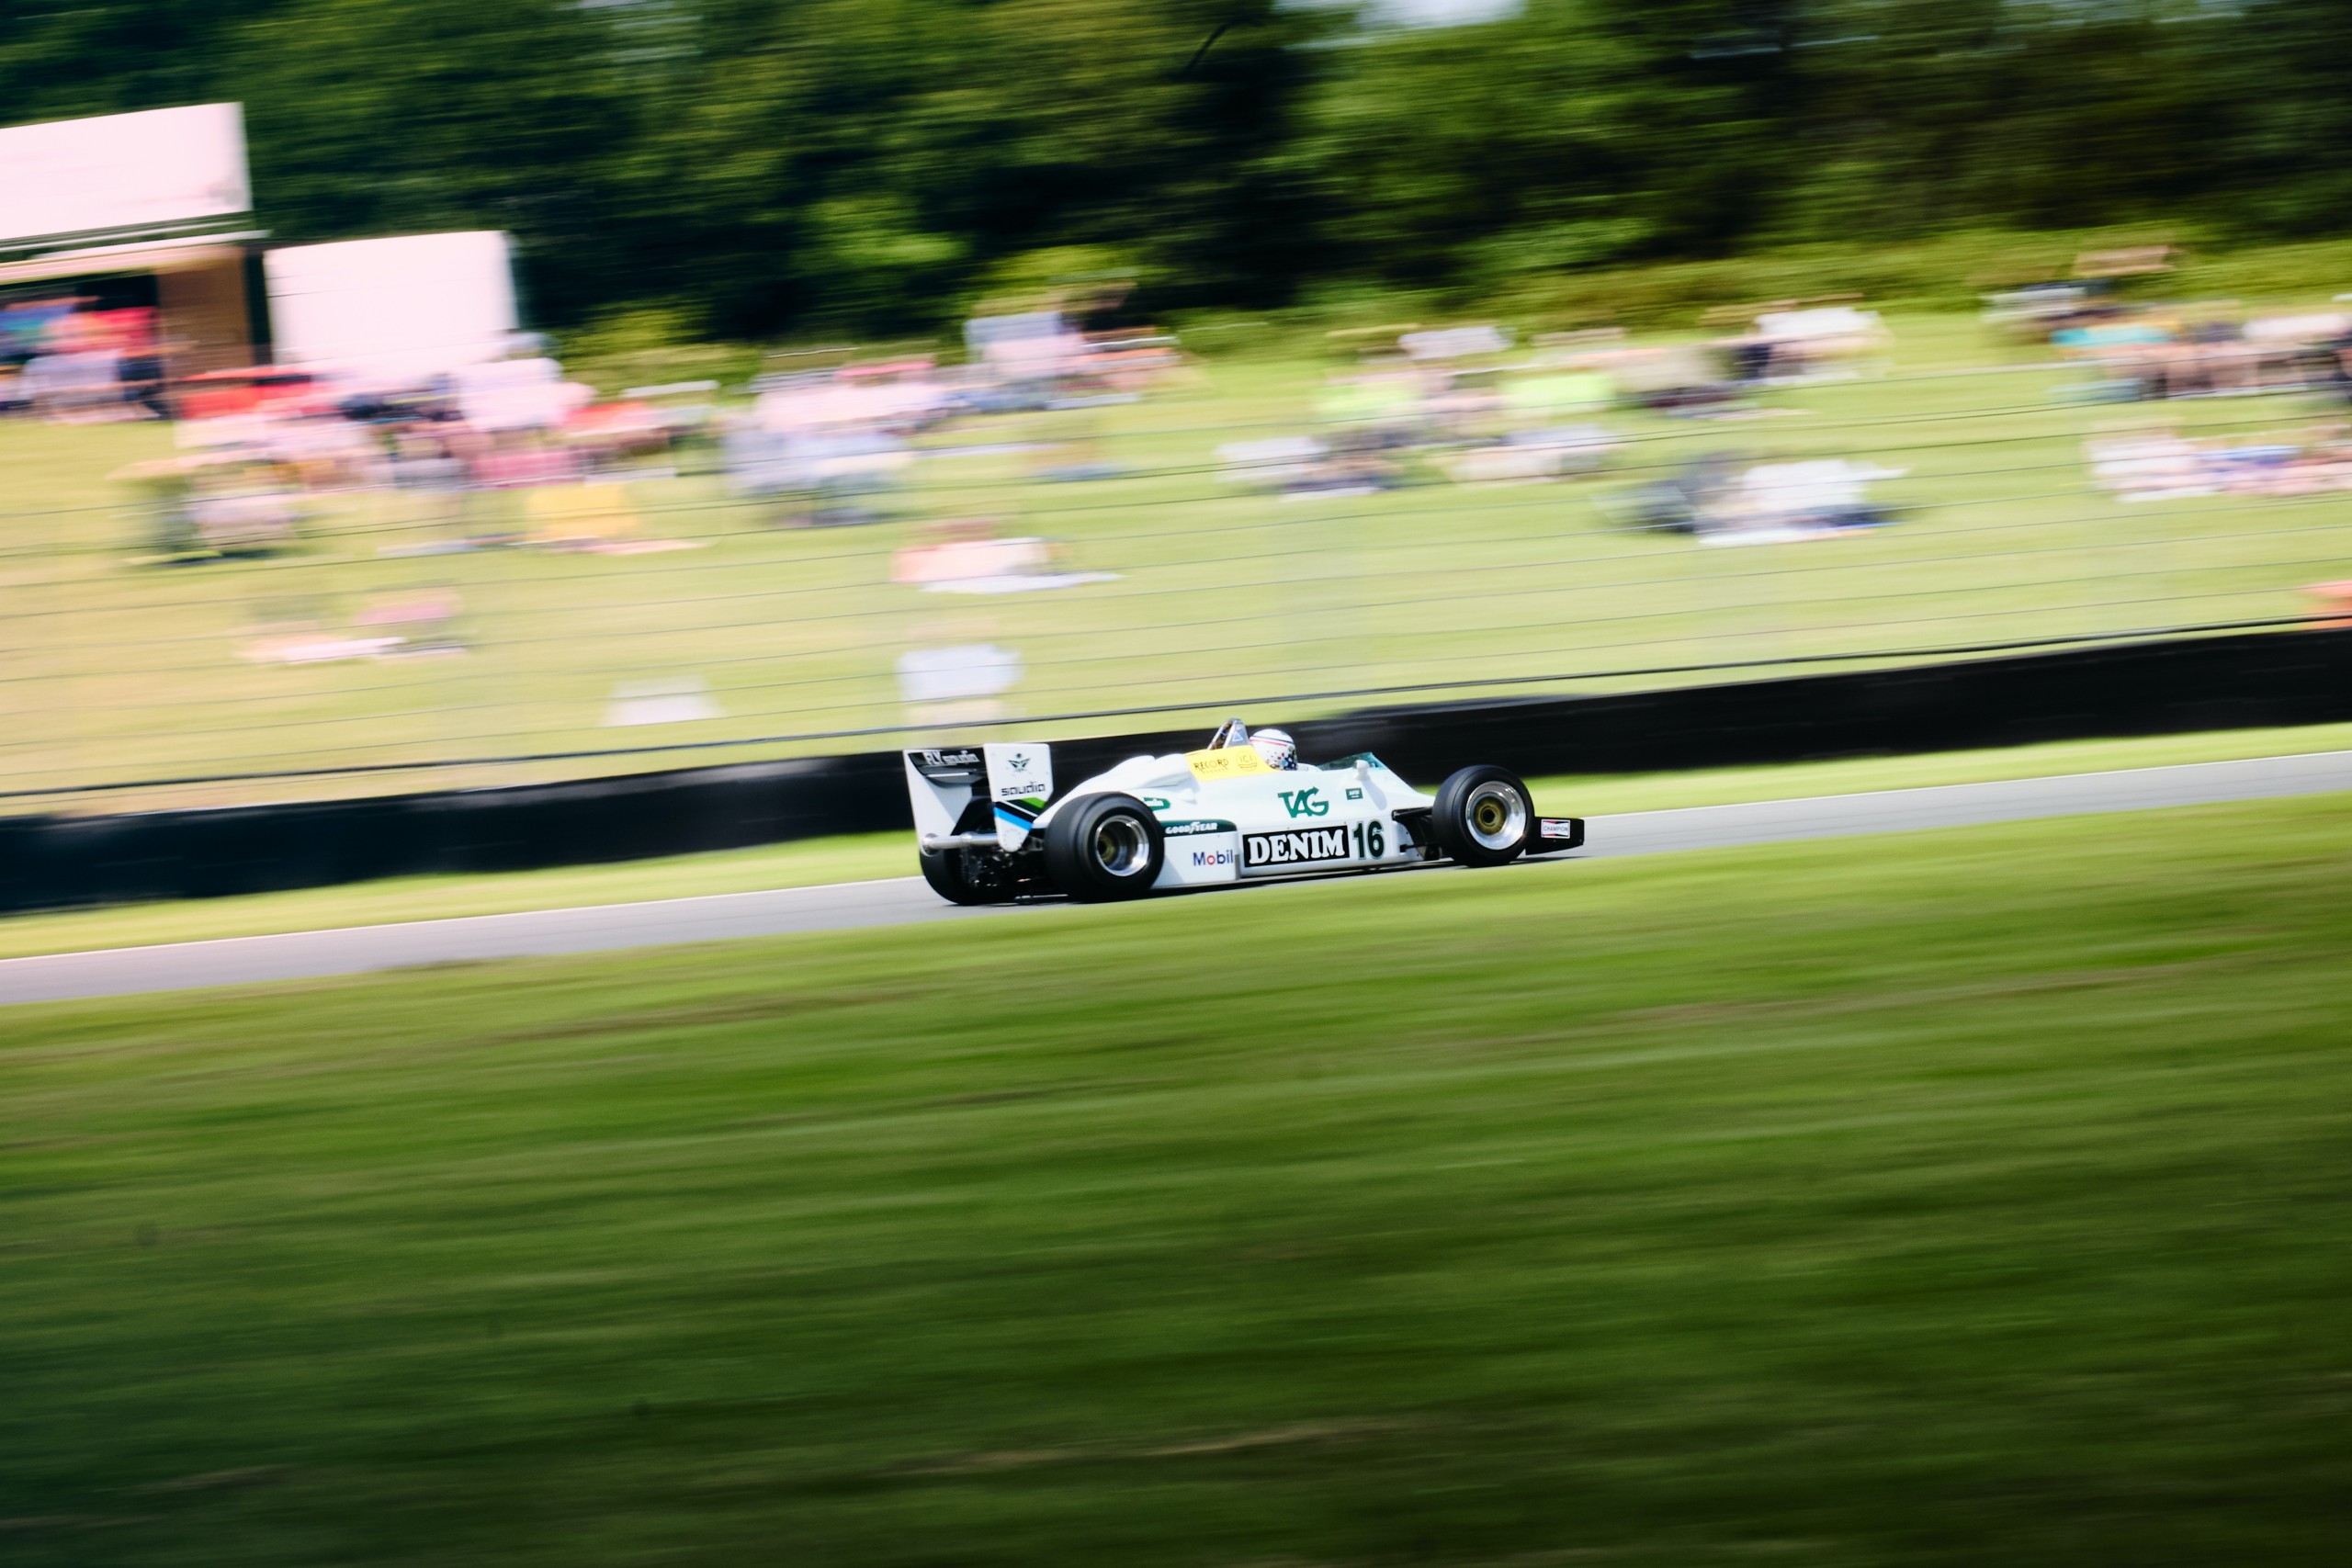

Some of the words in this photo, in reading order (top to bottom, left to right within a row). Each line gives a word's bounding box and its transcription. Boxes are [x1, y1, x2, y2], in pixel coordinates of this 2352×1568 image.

[1193, 759, 1229, 773] RECORD
[1001, 781, 1046, 796] saudia
[1277, 786, 1329, 818] TAG
[1165, 821, 1218, 834] GOODYEAR
[1248, 829, 1346, 864] DENIM
[1352, 820, 1385, 860] 16
[1193, 849, 1234, 867] Mobil
